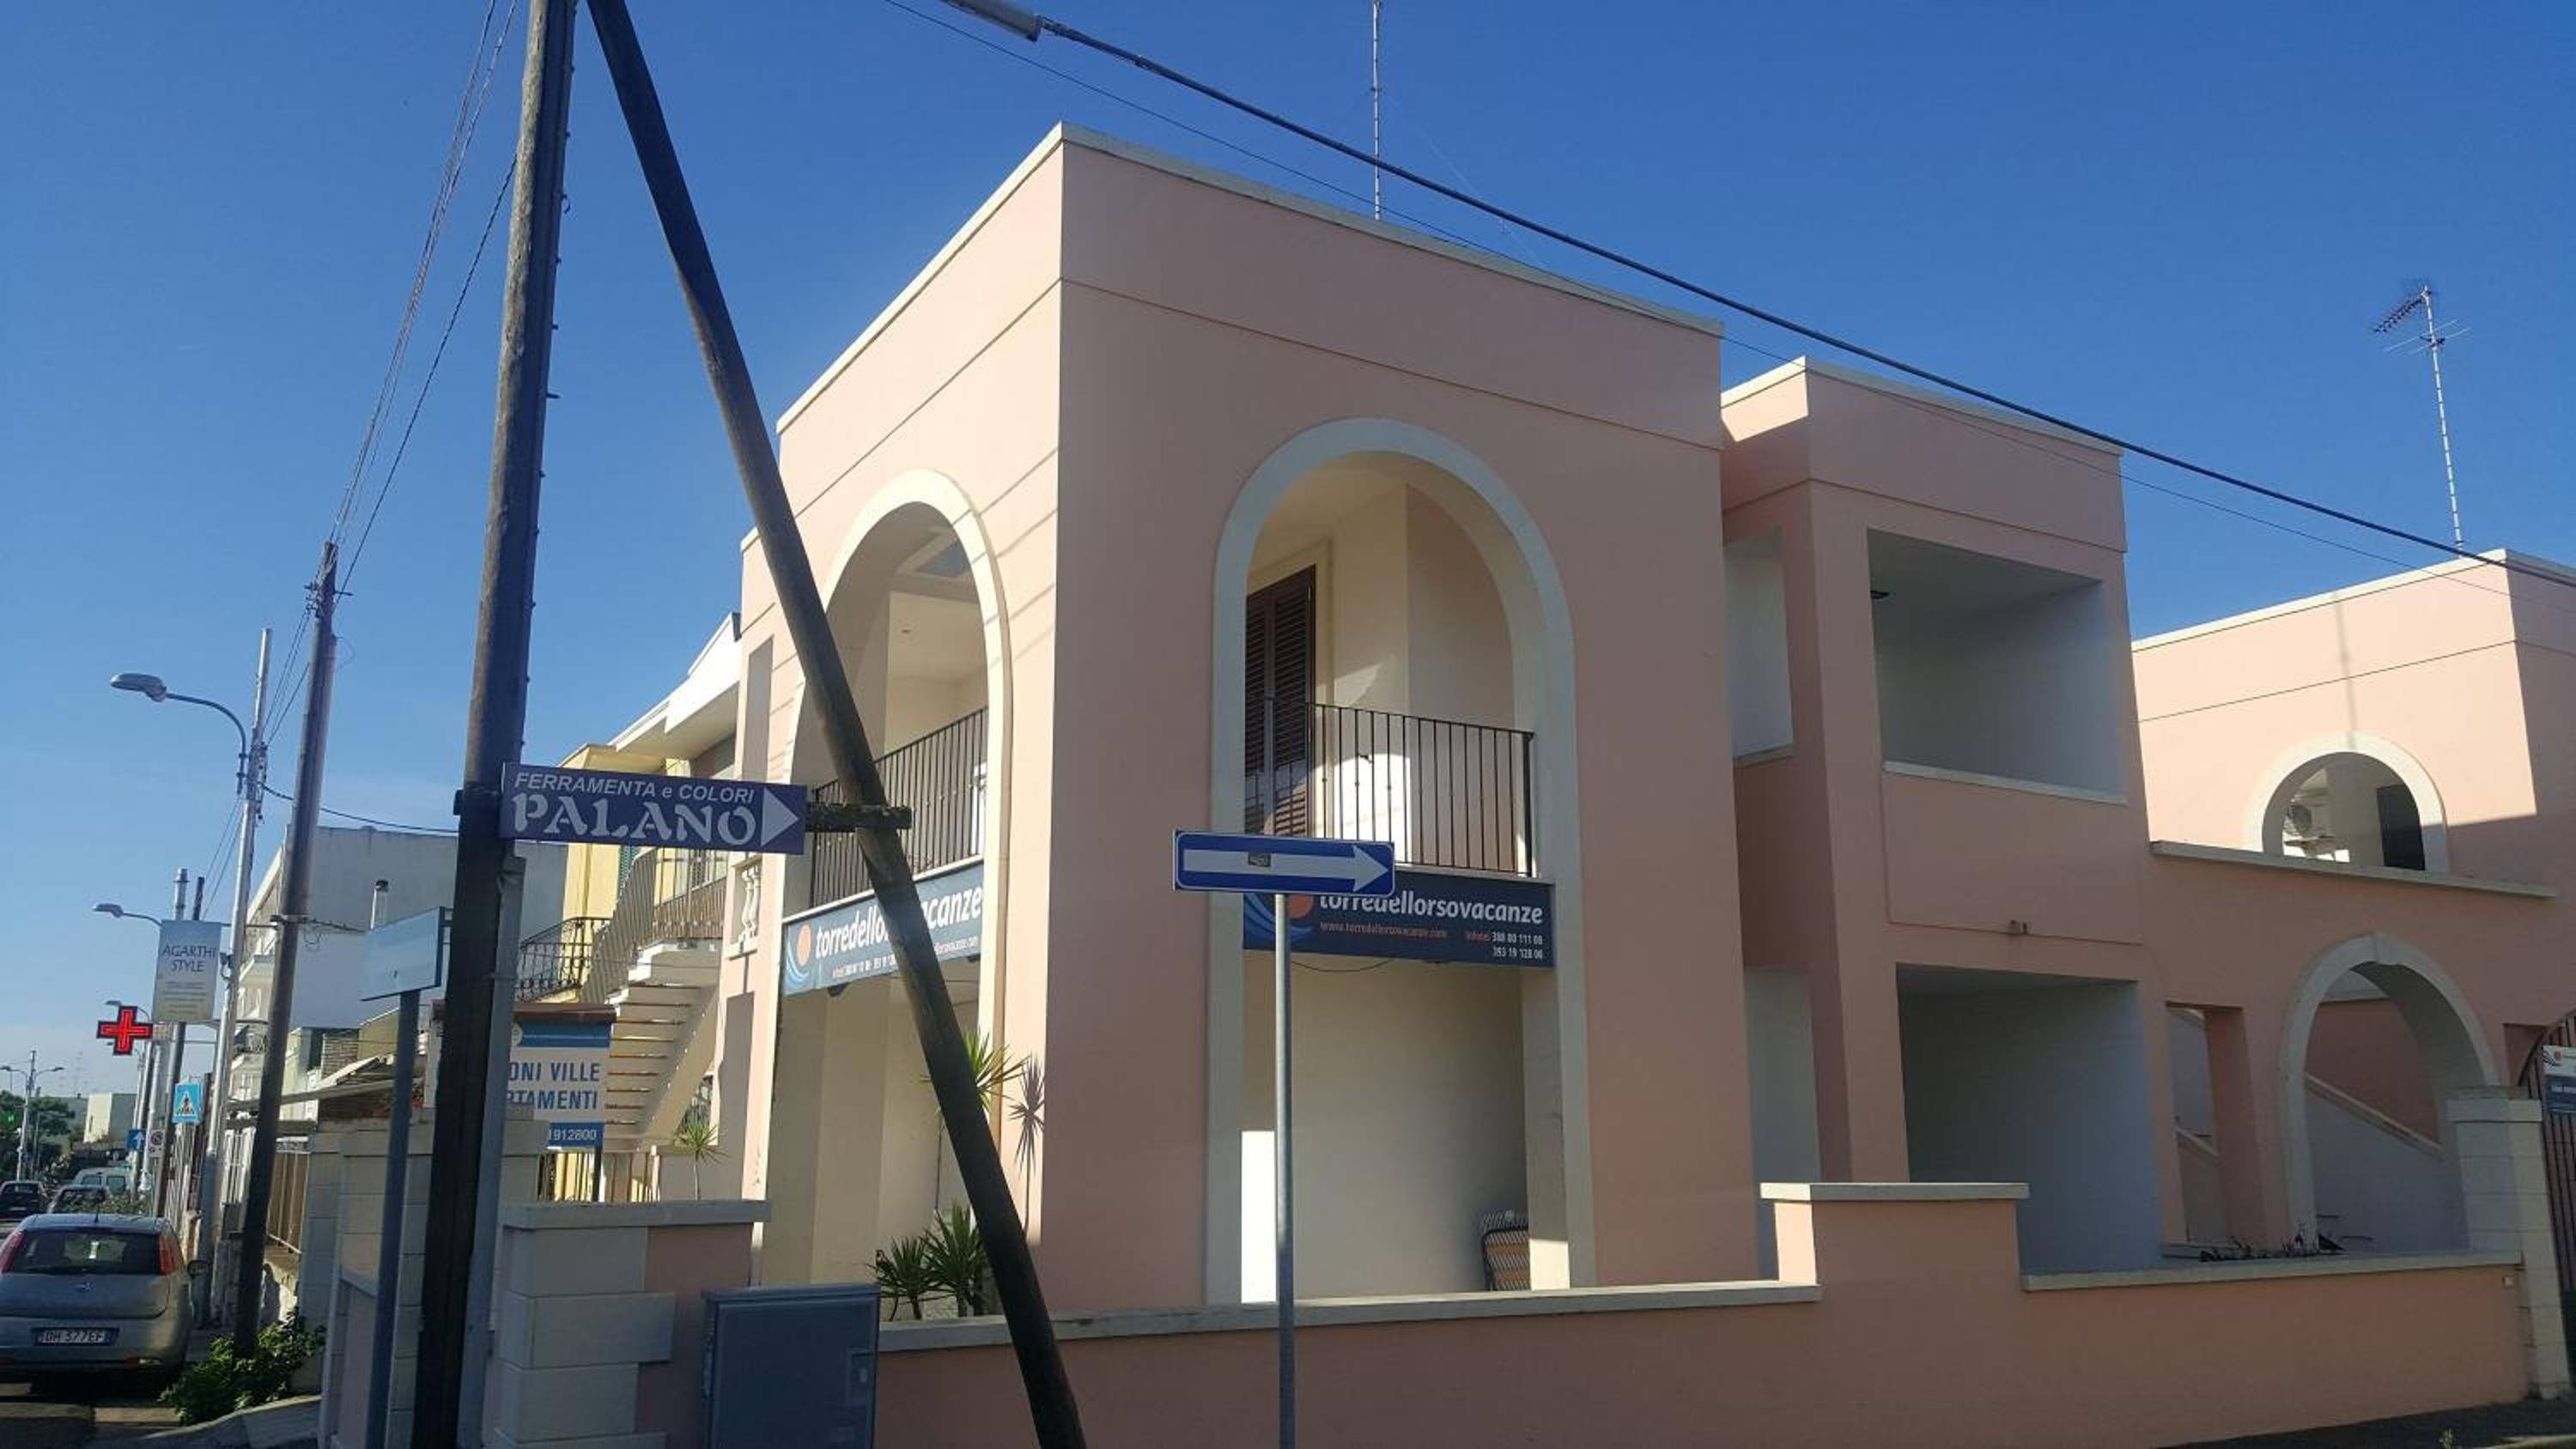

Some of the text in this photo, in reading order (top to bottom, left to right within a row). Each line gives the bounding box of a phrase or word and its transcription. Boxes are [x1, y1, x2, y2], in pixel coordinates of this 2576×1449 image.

[515, 772, 756, 804] FERRAMENTA e COLORI
[511, 791, 757, 846] PALANO
[171, 959, 206, 973] STYLE
[550, 1062, 601, 1082] VILLE
